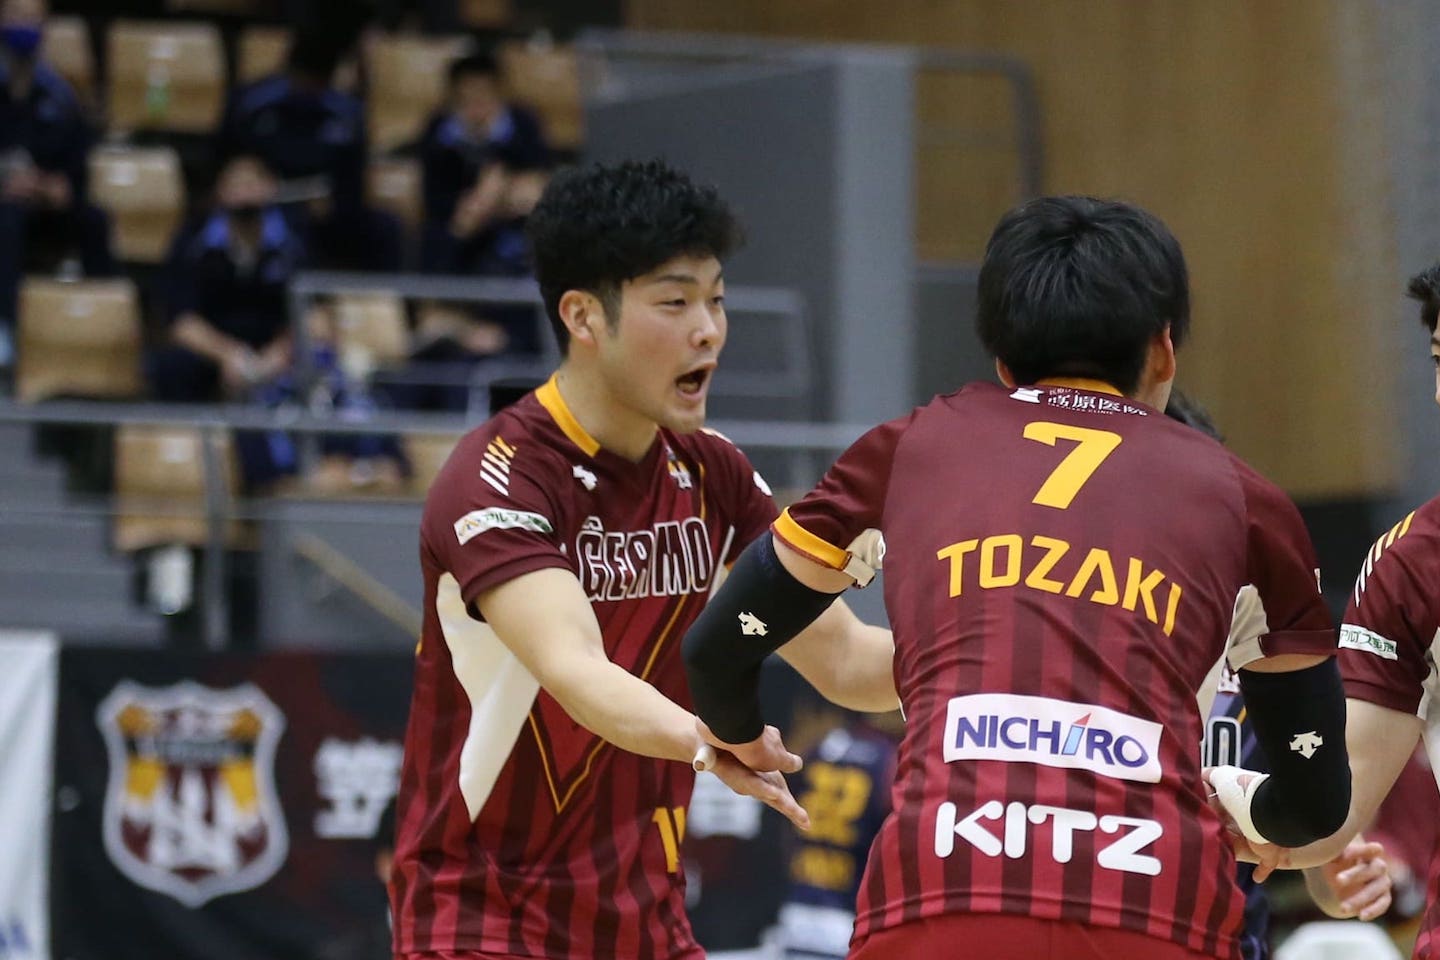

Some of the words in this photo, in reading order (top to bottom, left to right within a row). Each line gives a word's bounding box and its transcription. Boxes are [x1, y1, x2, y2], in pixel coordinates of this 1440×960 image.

[1023, 421, 1123, 510] 7
[936, 533, 1182, 638] TOZAKI
[955, 712, 1150, 768] NICHIRO
[934, 800, 1164, 876] KITZ
